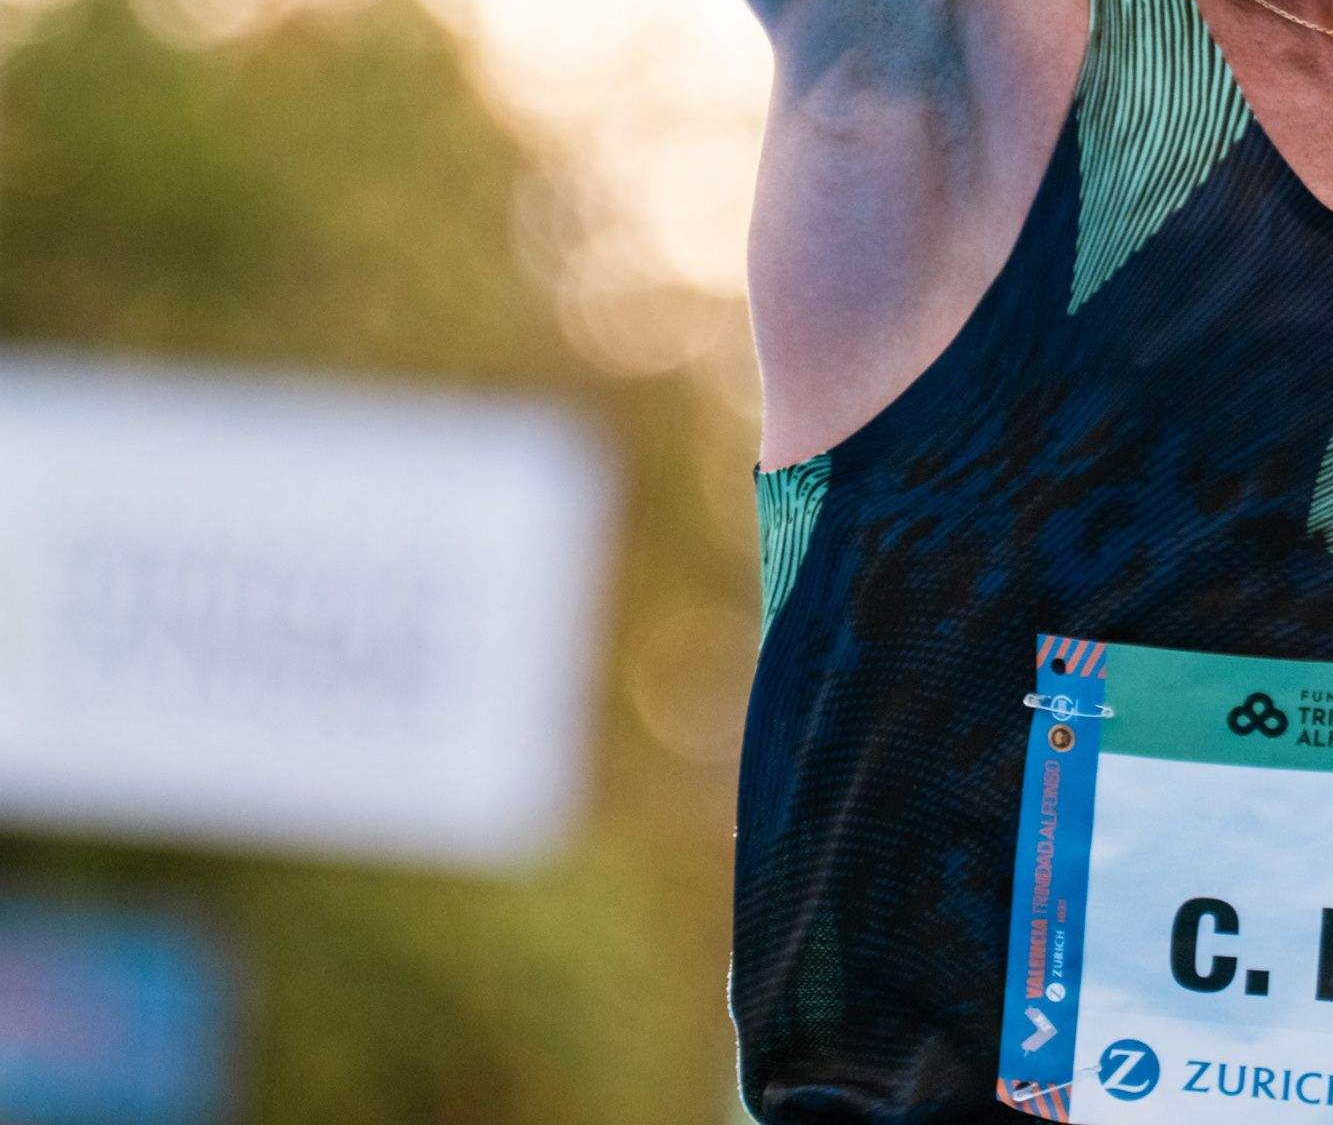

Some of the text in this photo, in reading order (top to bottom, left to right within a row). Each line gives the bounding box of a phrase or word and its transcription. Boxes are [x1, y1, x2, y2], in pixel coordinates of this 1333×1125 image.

[1026, 918, 1049, 999] VALENCIA
[1052, 930, 1065, 978] ZURICH
[1169, 896, 1270, 997] C.
